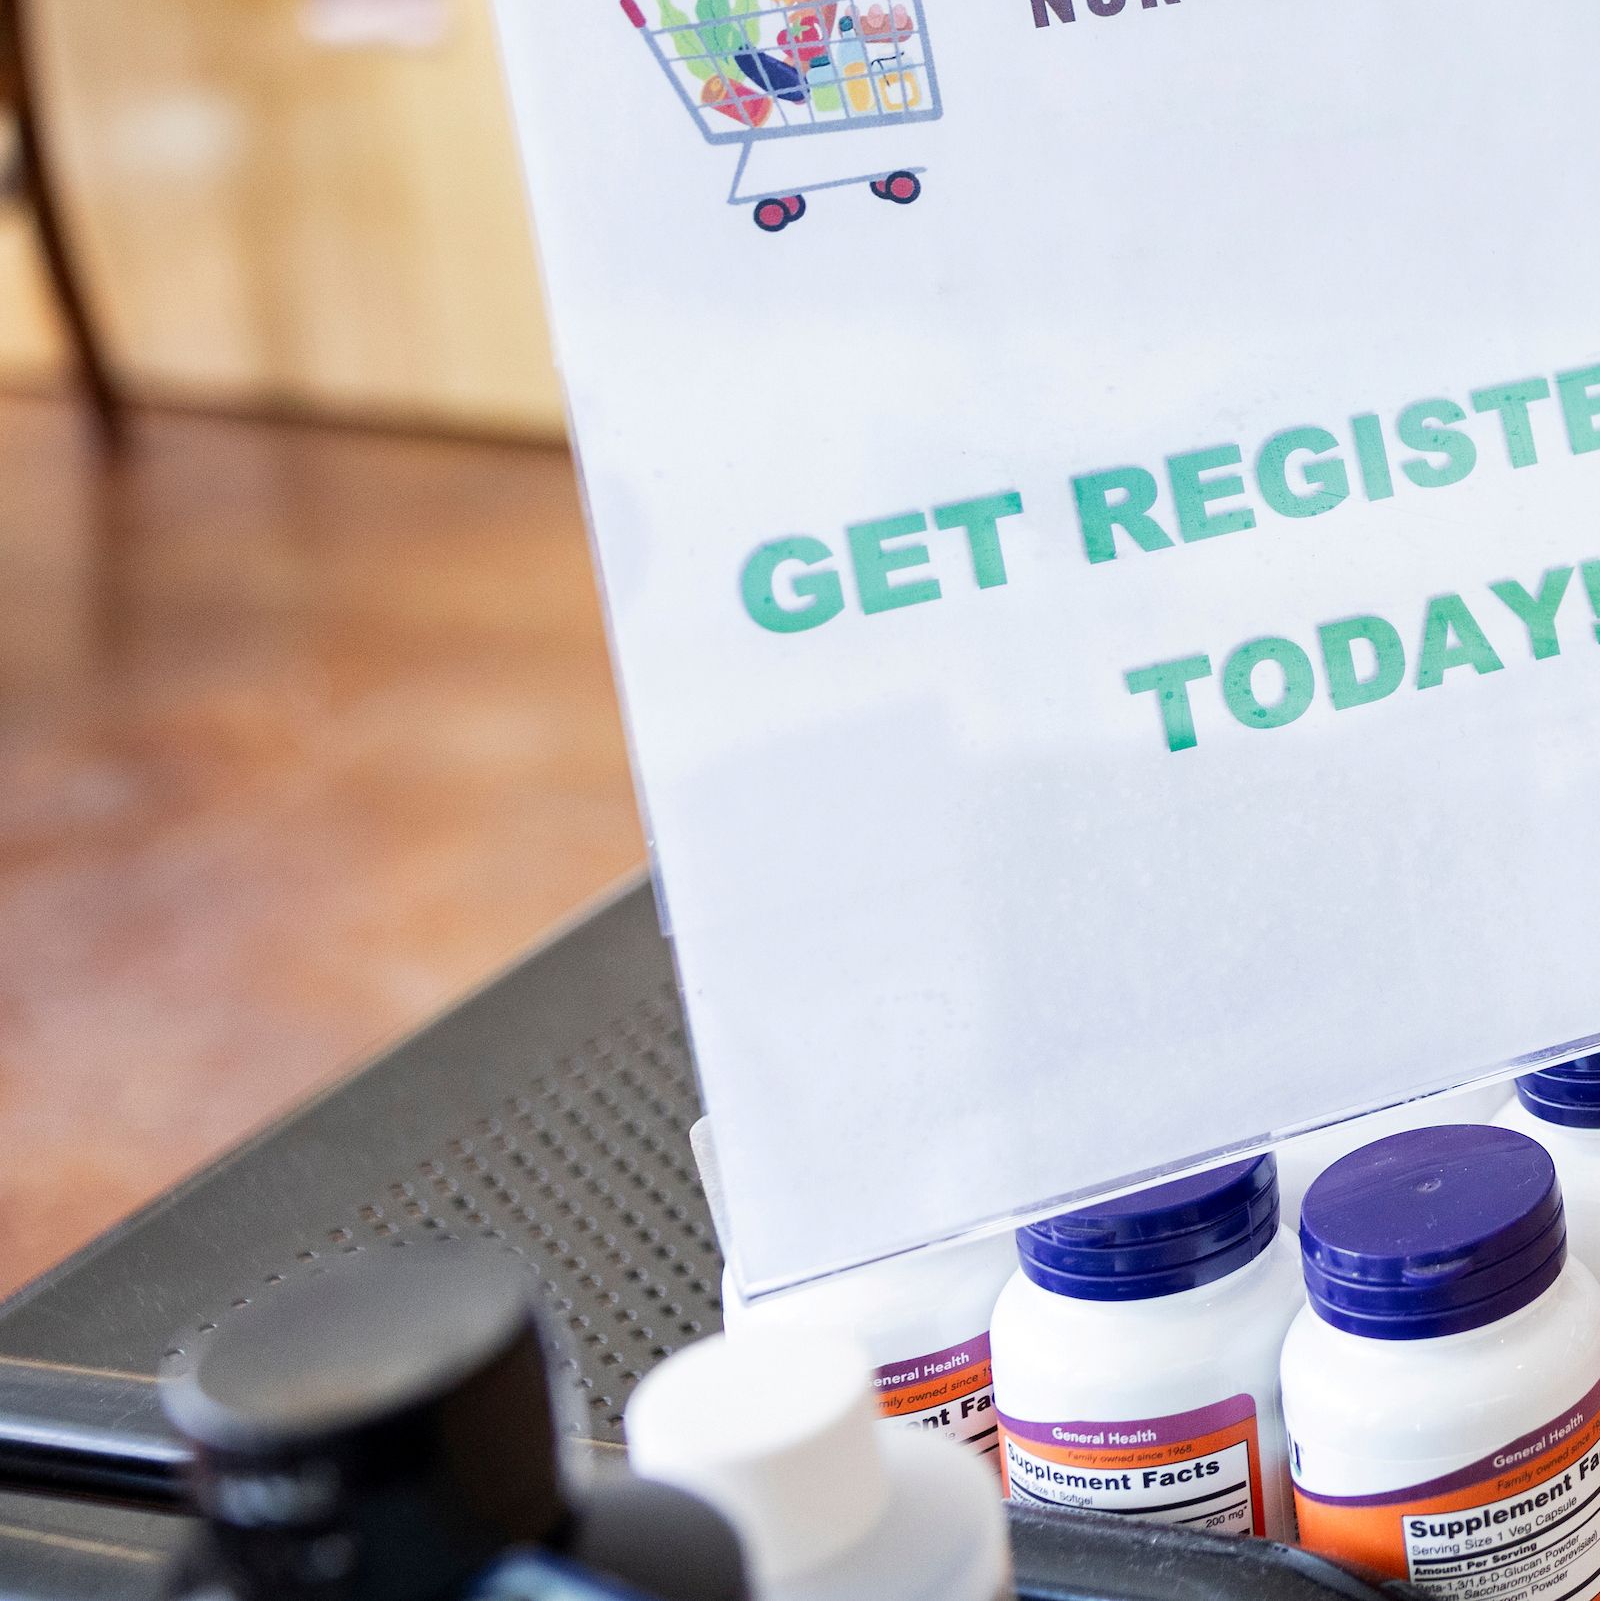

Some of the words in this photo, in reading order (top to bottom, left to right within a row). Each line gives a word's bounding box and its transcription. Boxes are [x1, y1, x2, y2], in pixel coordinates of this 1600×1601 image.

[738, 492, 1023, 634] GET
[873, 1367, 919, 1387] eneral
[924, 1352, 969, 1376] Health
[879, 1394, 904, 1409] mily
[907, 1384, 948, 1404] owned
[951, 1372, 979, 1391] since
[1052, 1426, 1104, 1445] General
[1108, 1429, 1157, 1445] Health
[1493, 1437, 1546, 1468] General
[1549, 1412, 1584, 1445] Health
[1007, 1442, 1132, 1491] Supplement
[1142, 1460, 1220, 1489] Facts
[1067, 1450, 1098, 1464] Family
[1100, 1453, 1134, 1463] owned
[1137, 1450, 1163, 1462] since
[1496, 1468, 1533, 1490] Family
[1536, 1447, 1569, 1475] owned
[1571, 1433, 1590, 1455] since
[1205, 1515, 1225, 1529] 200
[1410, 1473, 1572, 1539] Supplement
[1412, 1543, 1460, 1556] Serving
[1465, 1535, 1493, 1550] Size
[1497, 1532, 1503, 1541] 1
[1509, 1523, 1532, 1538] Veg
[1535, 1495, 1578, 1527] Capsule
[1414, 1564, 1462, 1576] Amount
[1466, 1558, 1488, 1571] Per
[1492, 1542, 1538, 1564] Serving
[1545, 1534, 1580, 1561] Powder
[1464, 1565, 1551, 1599] Saccharomyces
[1531, 1569, 1569, 1596] Powder
